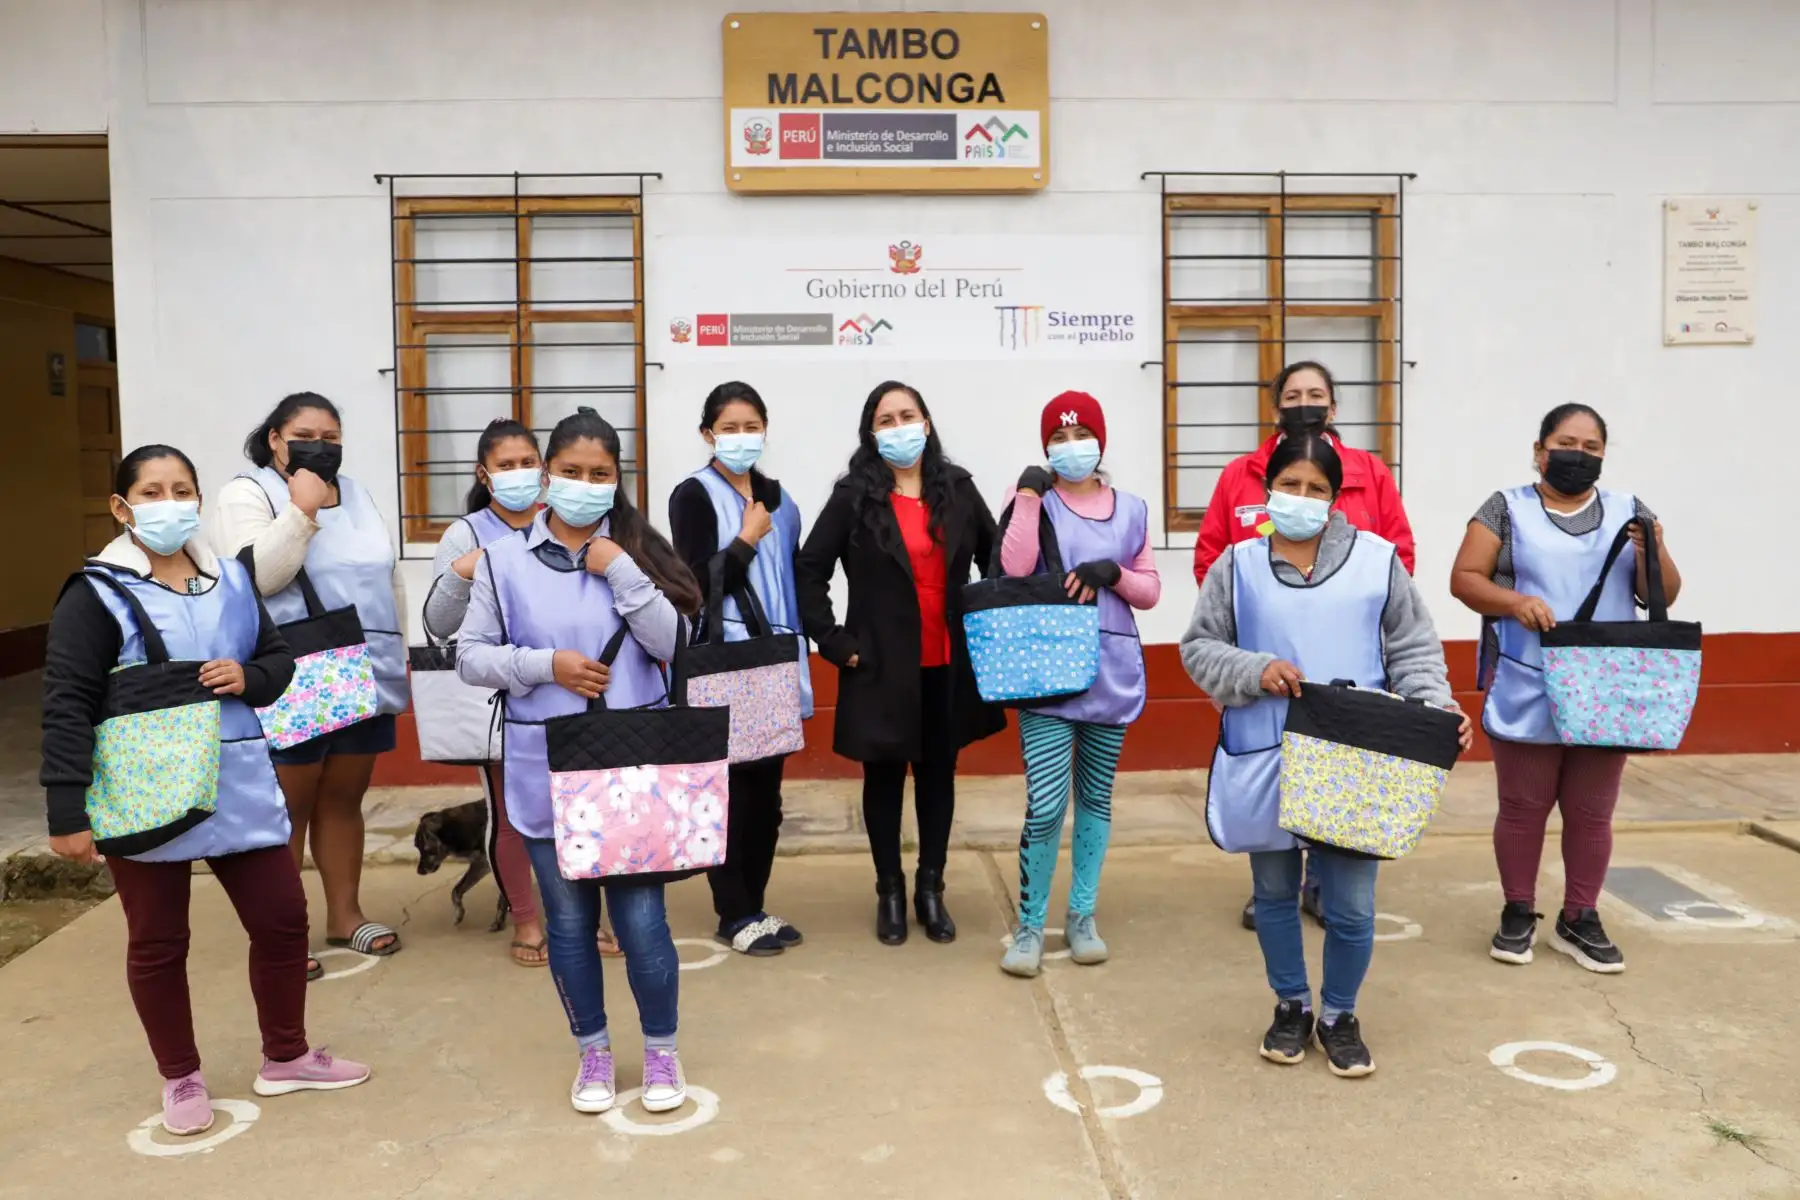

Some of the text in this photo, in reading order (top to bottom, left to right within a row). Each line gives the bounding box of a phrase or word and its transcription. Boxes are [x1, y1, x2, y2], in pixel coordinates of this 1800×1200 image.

[813, 28, 960, 60] TAMBO
[767, 72, 1006, 105] MALCONGA
[783, 128, 816, 143] PERÚ
[827, 130, 949, 141] Ministerio de Desarrollo
[826, 141, 913, 153] e Inclusión Social
[806, 277, 1003, 299] Gobierno del Perú
[1048, 311, 1134, 330] Siempre
[700, 323, 726, 336] PERÚ
[1079, 329, 1134, 345] pueblo
